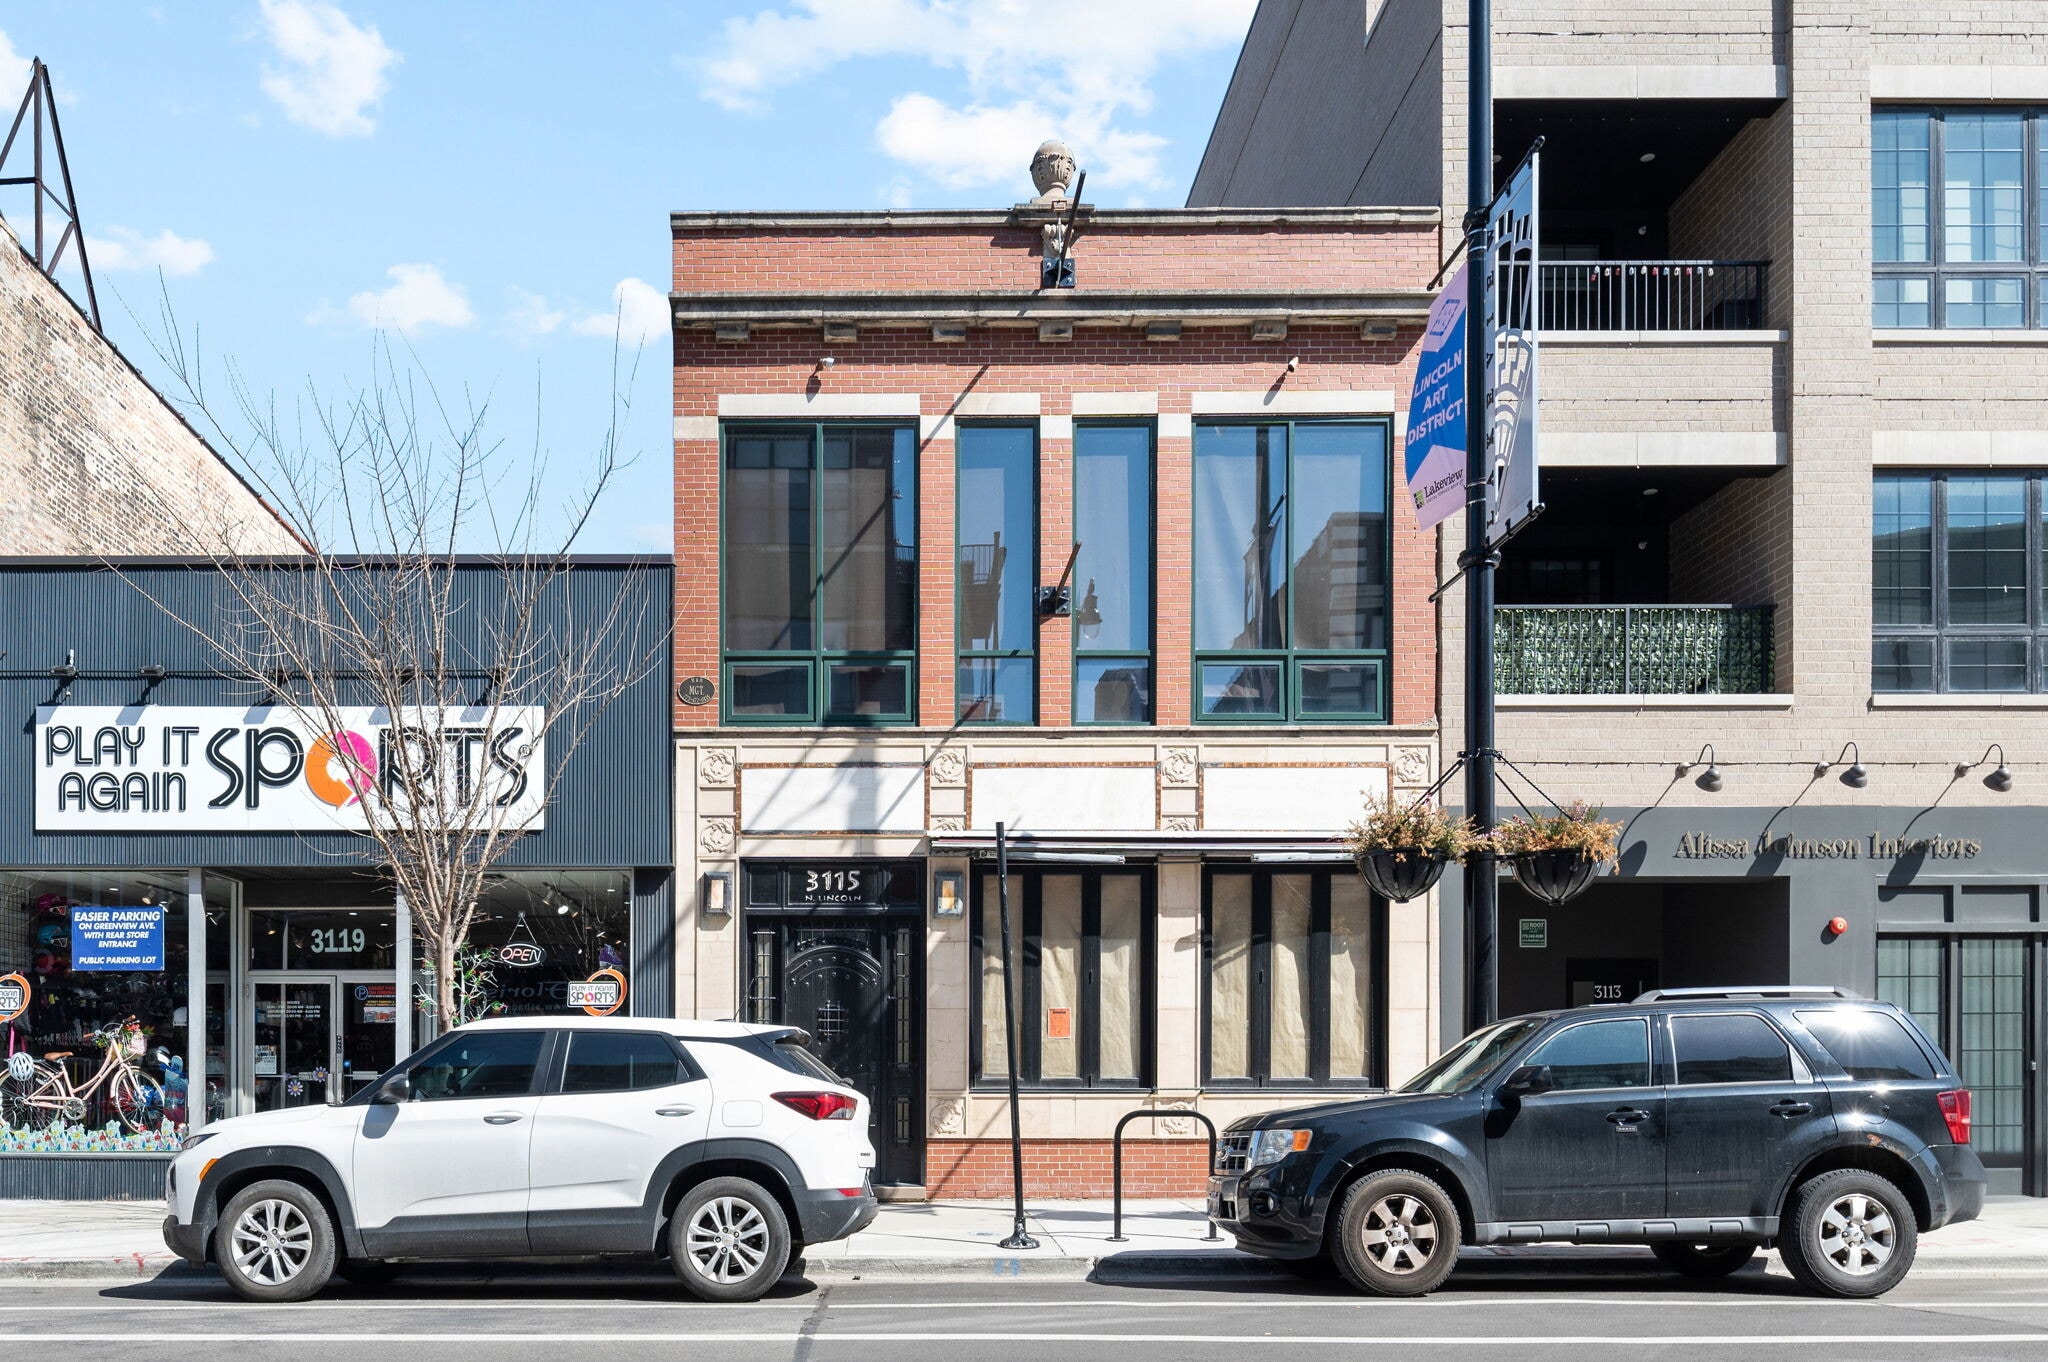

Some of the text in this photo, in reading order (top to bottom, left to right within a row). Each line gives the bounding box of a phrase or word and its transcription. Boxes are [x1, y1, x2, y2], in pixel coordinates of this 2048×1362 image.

[1413, 349, 1462, 399] LINCOLN
[1422, 384, 1448, 414] ART
[1407, 398, 1463, 446] DISTRICT
[1424, 469, 1463, 498] Lakeview
[46, 725, 200, 766] PLAY IT
[205, 727, 528, 811] SPORTS
[58, 772, 187, 812] AGAIN
[1677, 830, 1983, 855] Alissa Johnson Interiors
[806, 870, 861, 892] 3115
[805, 894, 861, 902] N. LINCOLN
[74, 911, 160, 922] EASIER PARKING
[94, 922, 138, 930] GREENVIEW
[139, 922, 156, 930] AVE.
[84, 931, 149, 939] WITH REAR STORE
[98, 940, 138, 948] ENTRANCE
[311, 928, 365, 953] 3119
[106, 956, 141, 964] PARKING
[500, 948, 542, 961] OPEN
[571, 992, 615, 1004] SPORTS
[1594, 985, 1622, 999] 3113
